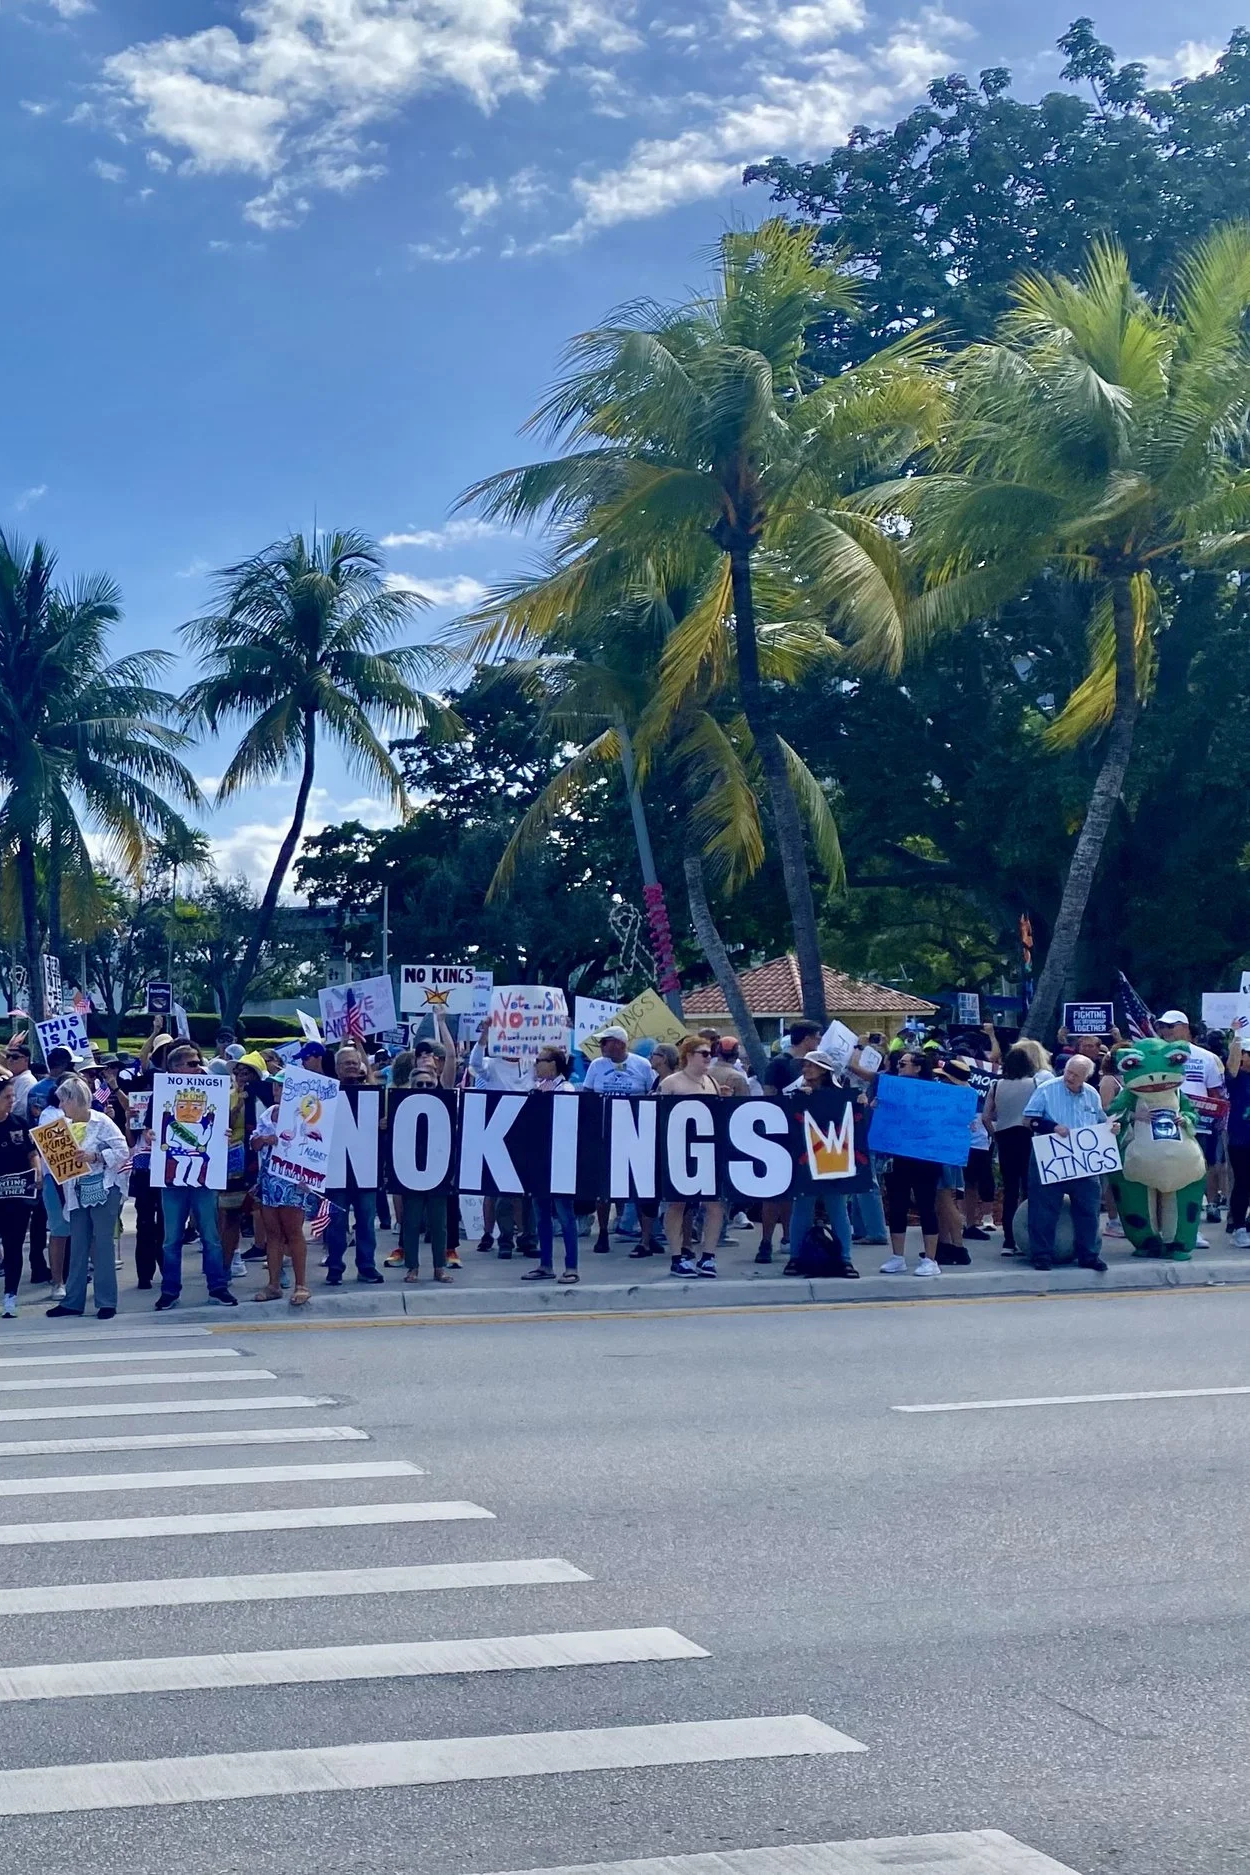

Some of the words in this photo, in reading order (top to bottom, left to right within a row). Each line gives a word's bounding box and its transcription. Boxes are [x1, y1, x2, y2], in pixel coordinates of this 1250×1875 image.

[404, 968, 426, 983] NO
[432, 968, 474, 983] KINGS
[493, 1010, 523, 1028] NO
[524, 1015, 540, 1027] TO
[1073, 1011, 1107, 1019] FIGHTING
[38, 1015, 79, 1035] THIS
[43, 1033, 60, 1047] IS
[66, 1029, 77, 1040] A
[167, 1076, 183, 1086] NO
[38, 1122, 59, 1143] No
[43, 1135, 77, 1154] Kings
[1048, 1128, 1099, 1158] NO
[1040, 1147, 1118, 1183] KINGS
